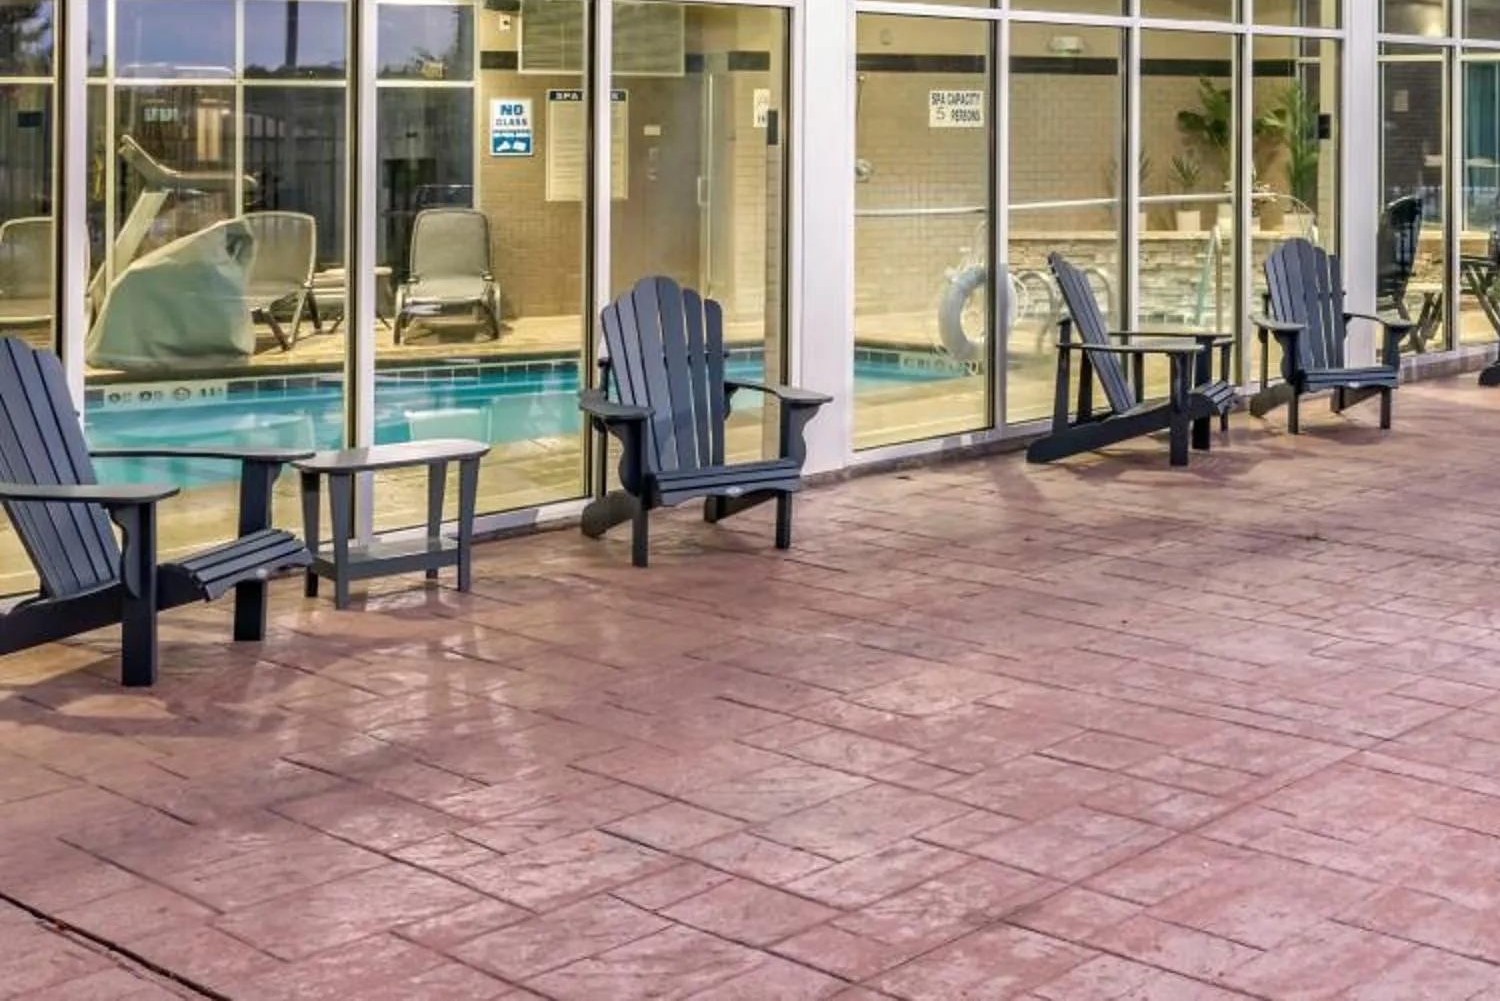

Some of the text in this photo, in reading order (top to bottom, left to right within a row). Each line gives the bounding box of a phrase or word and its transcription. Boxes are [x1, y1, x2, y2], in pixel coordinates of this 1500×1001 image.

[931, 93, 981, 105] SPA CAPACITY
[500, 104, 524, 115] NO
[951, 109, 981, 121] PERSONS
[495, 118, 528, 127] GLASS
